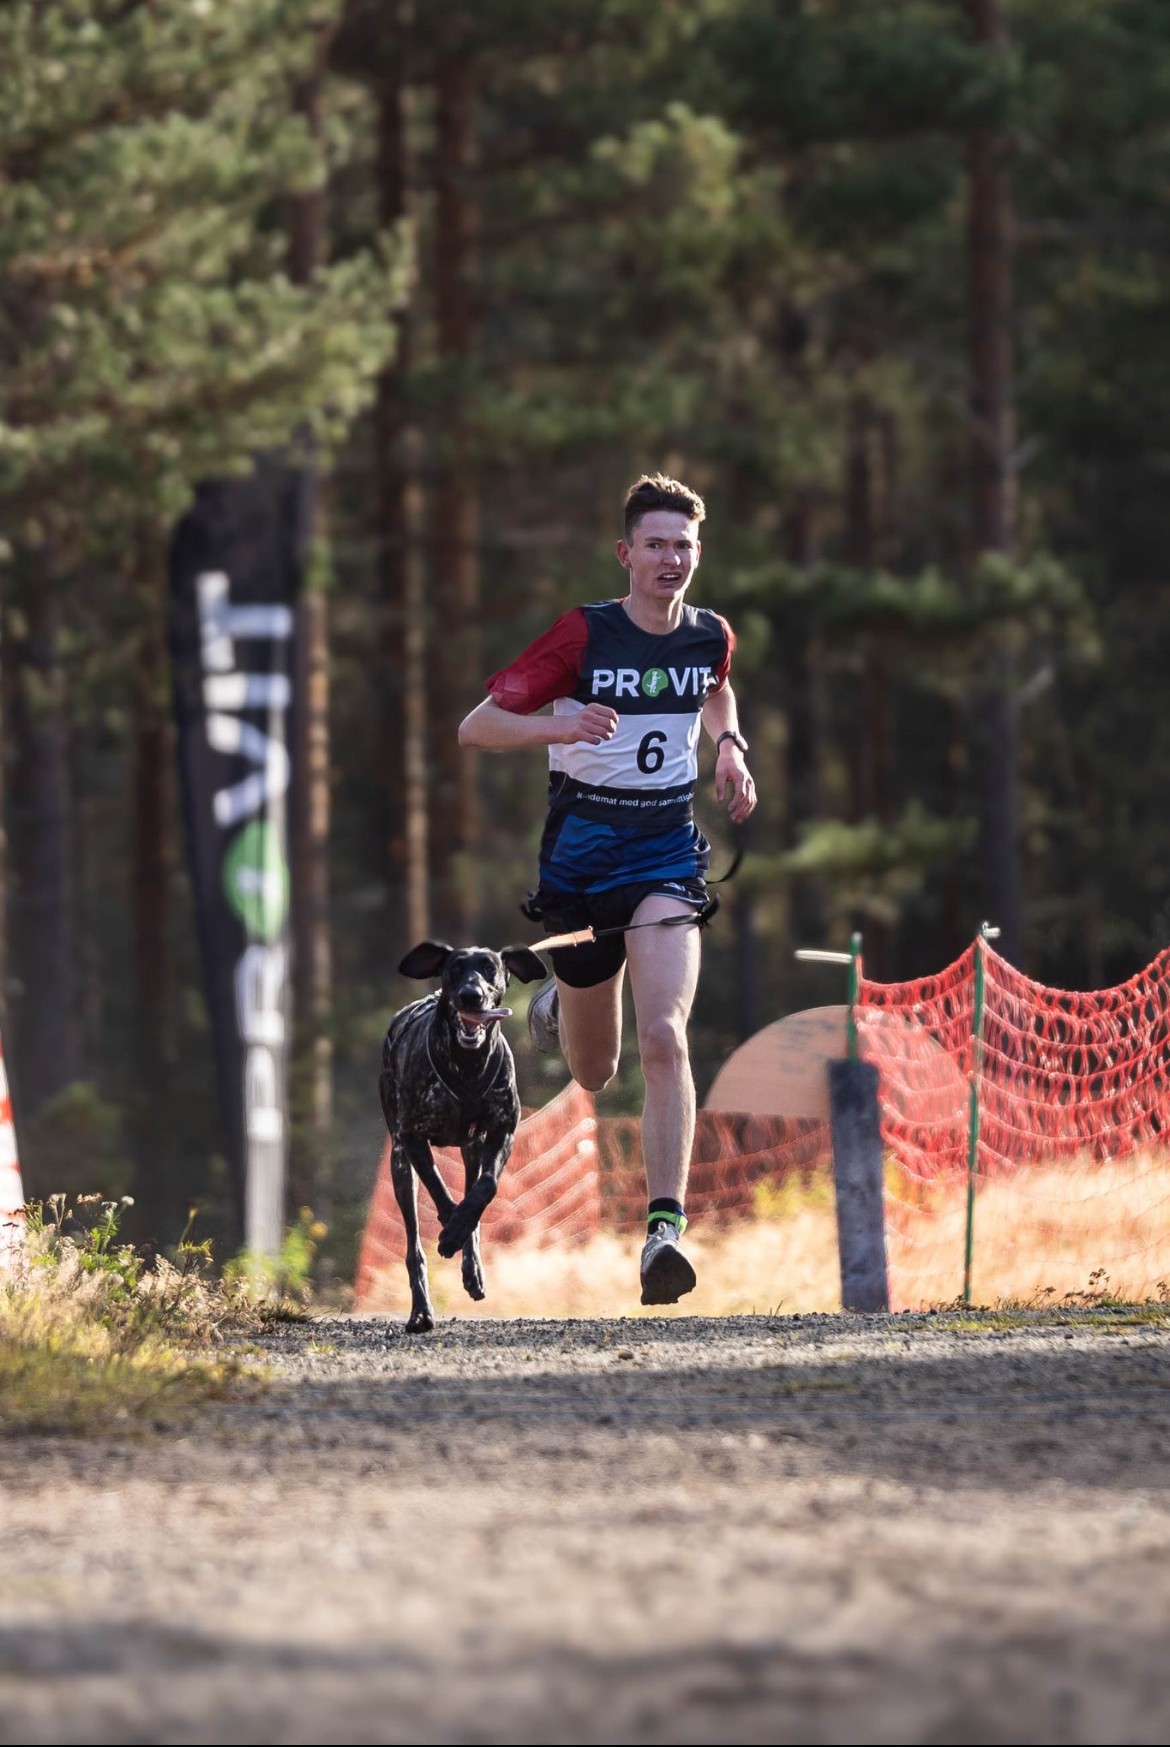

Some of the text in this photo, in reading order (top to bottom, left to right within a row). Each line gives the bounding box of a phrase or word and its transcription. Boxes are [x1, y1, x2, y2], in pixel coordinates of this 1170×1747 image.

[637, 730, 667, 774] 6
[619, 799, 639, 807] med
[640, 799, 657, 808] god
